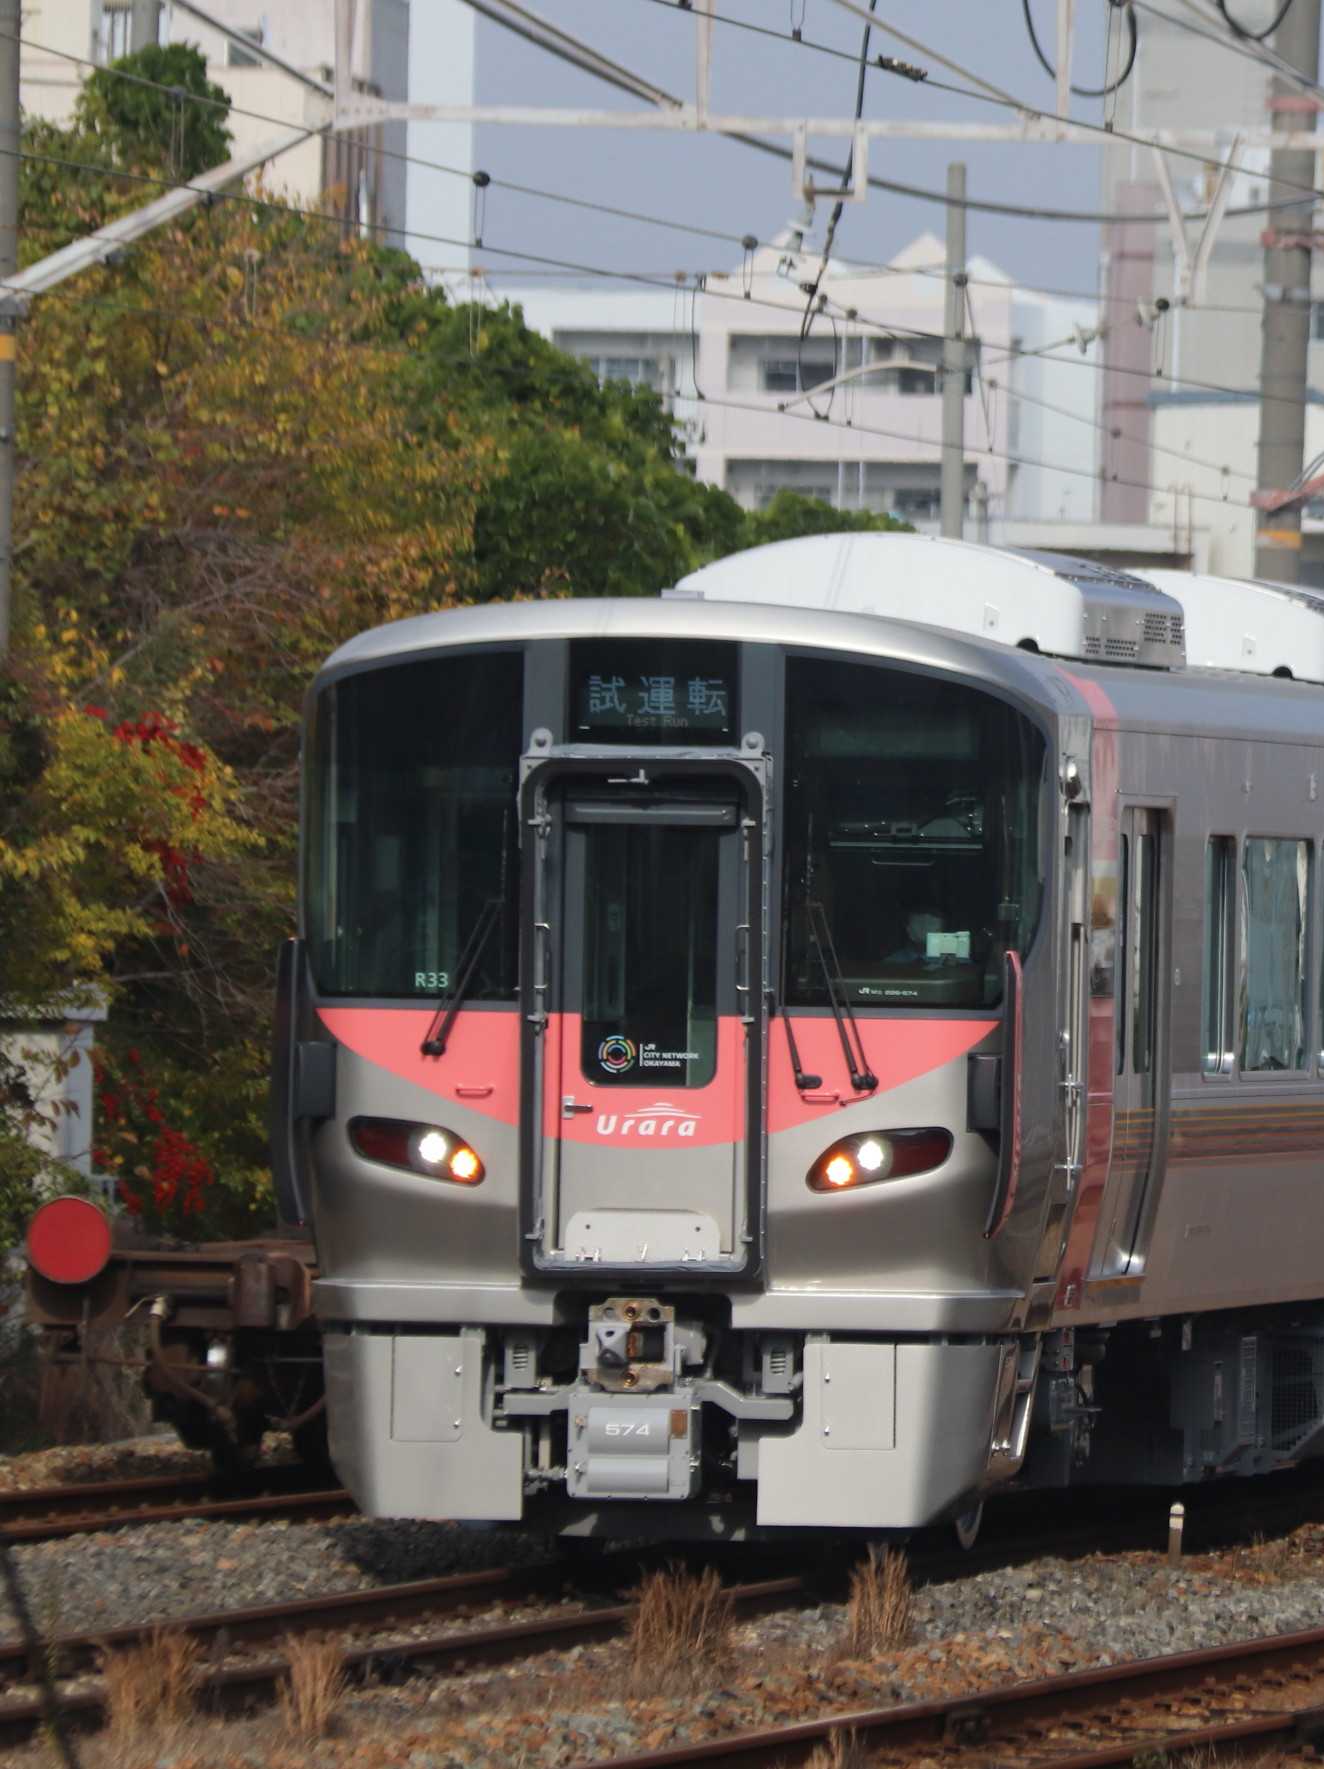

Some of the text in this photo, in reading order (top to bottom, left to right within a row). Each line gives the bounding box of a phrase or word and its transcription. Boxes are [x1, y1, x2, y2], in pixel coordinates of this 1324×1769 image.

[589, 675, 727, 716] 試運転
[626, 714, 689, 728] Test Run
[415, 971, 449, 988] R33
[644, 1043, 656, 1051] JR
[643, 1051, 699, 1060] CITY NETWORK
[596, 1114, 696, 1137] Urara
[605, 1423, 651, 1436] 574
